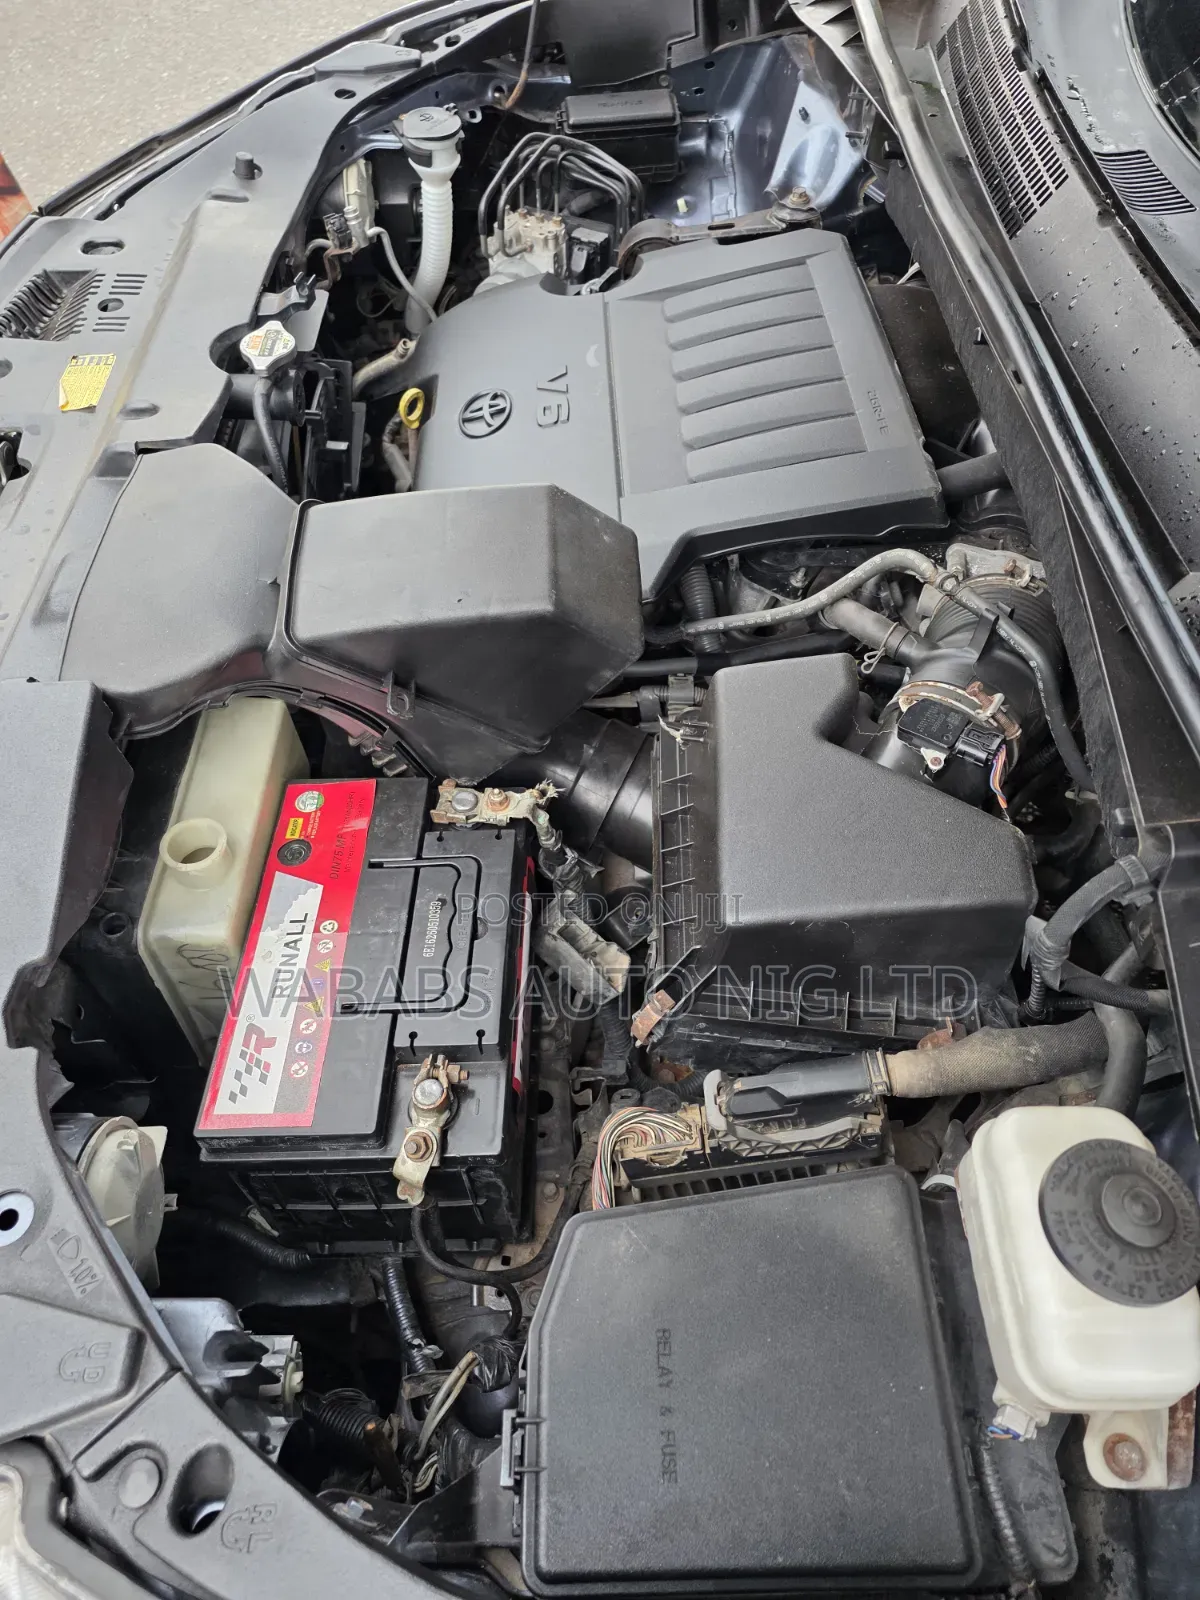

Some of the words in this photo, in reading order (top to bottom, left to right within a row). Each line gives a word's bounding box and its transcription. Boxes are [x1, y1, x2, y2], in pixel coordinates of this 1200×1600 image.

[535, 364, 571, 430] V6
[329, 850, 344, 880] DIN75
[271, 912, 308, 998] RUNALL
[655, 1328, 674, 1389] RELAY
[659, 1405, 675, 1418] &
[660, 1429, 678, 1485] FUSE
